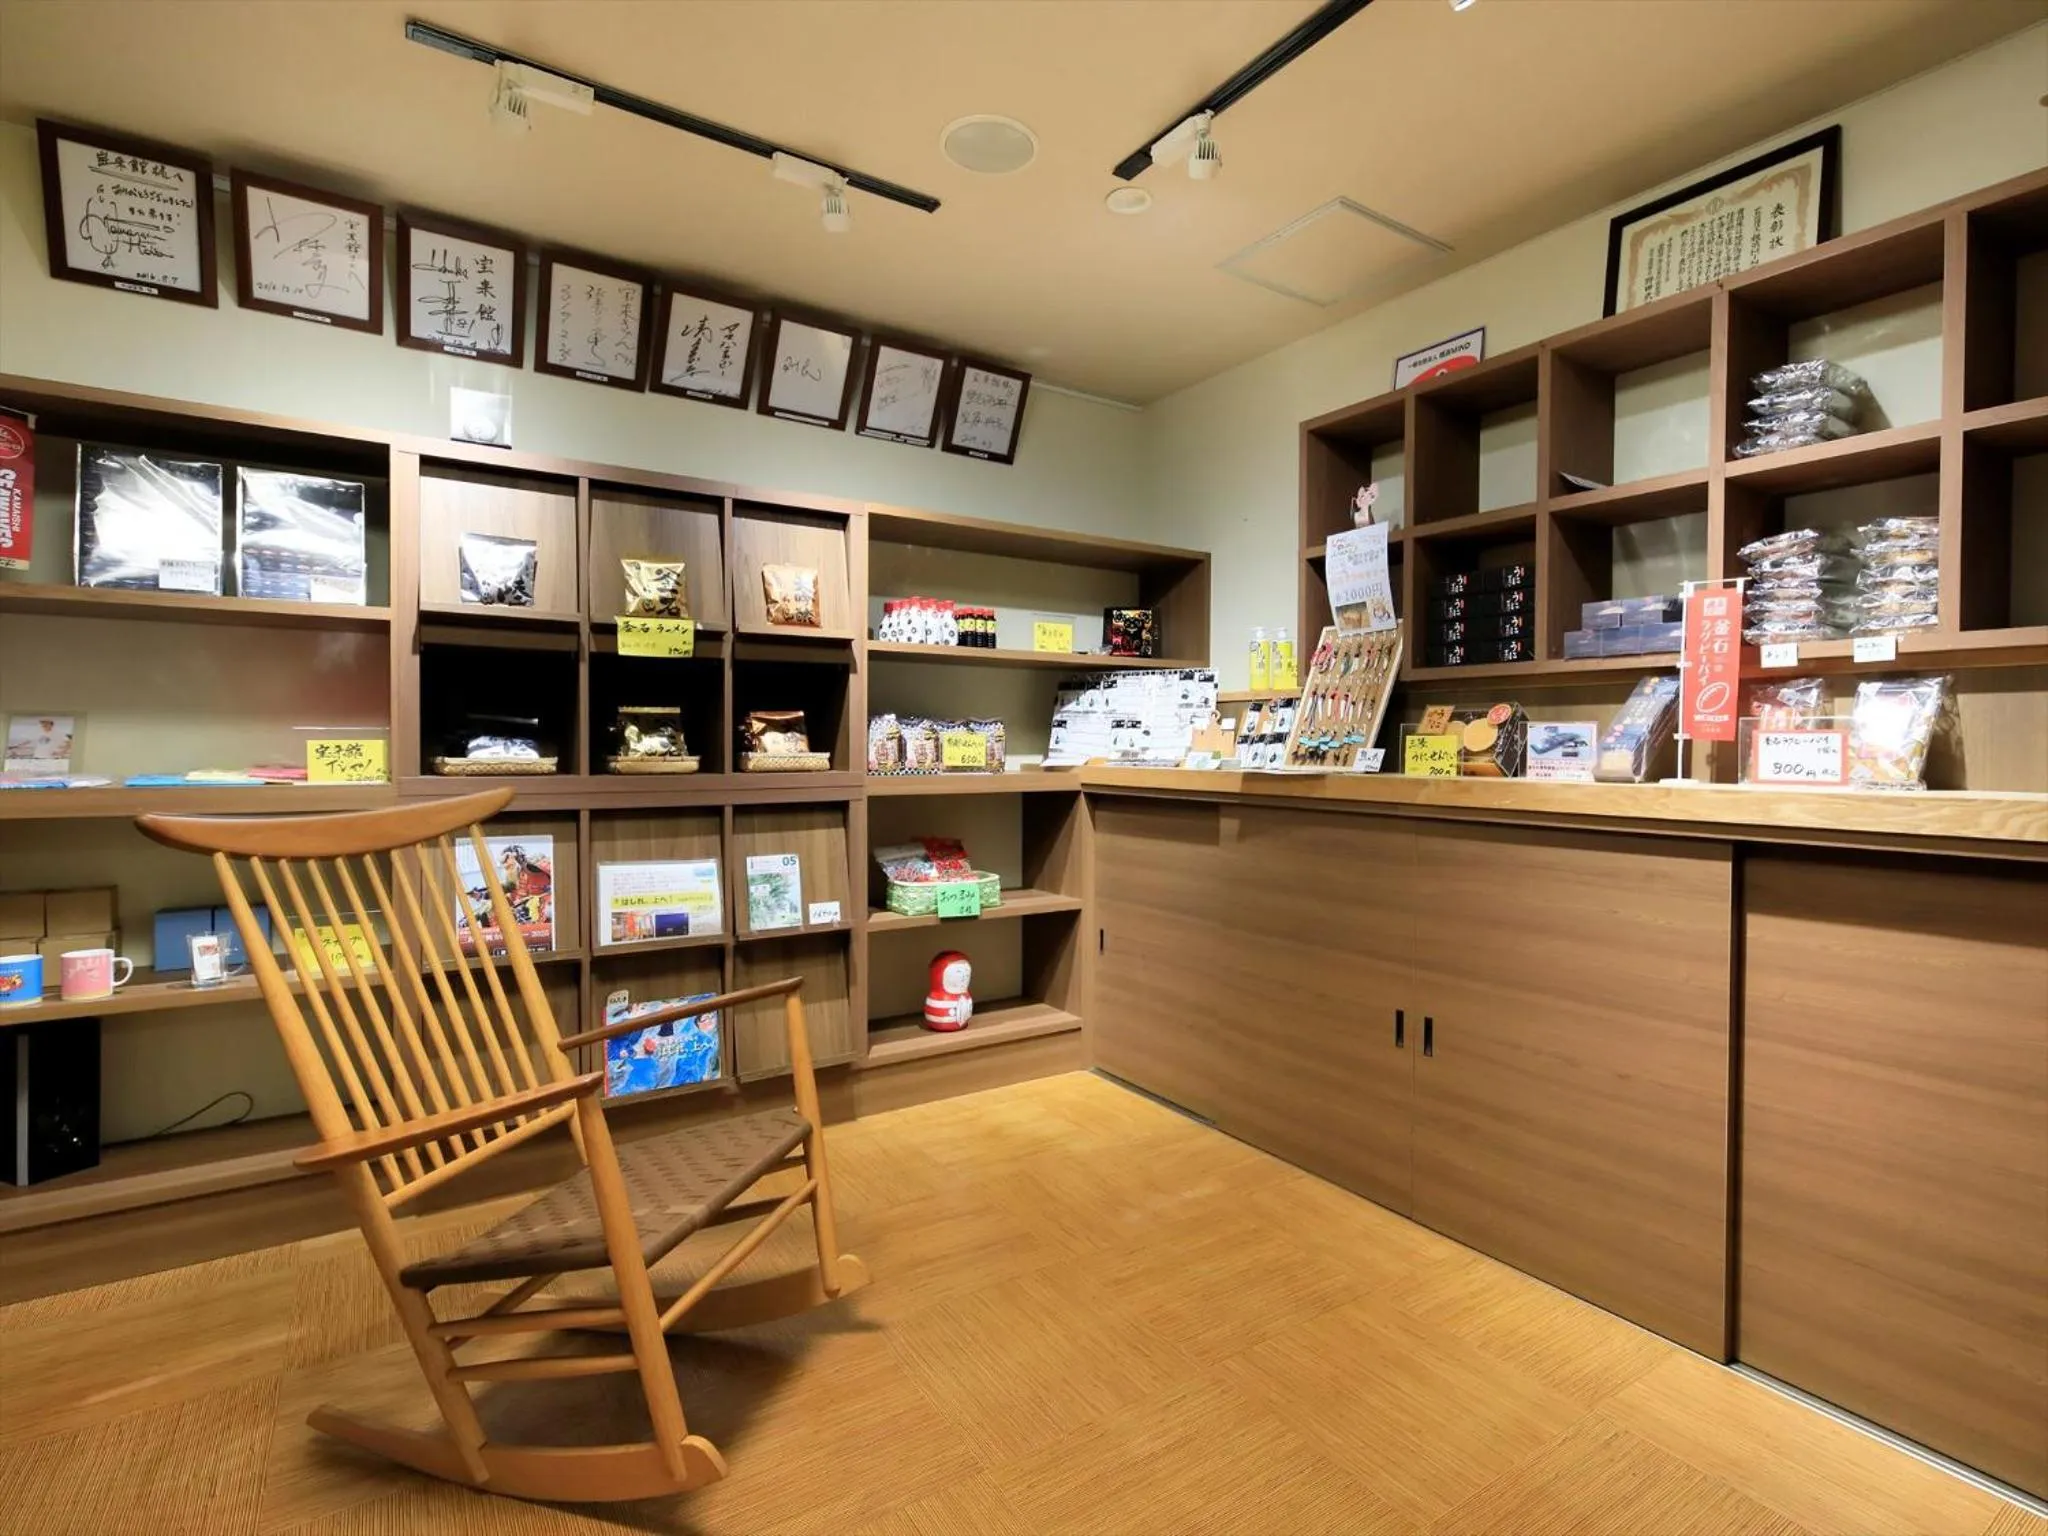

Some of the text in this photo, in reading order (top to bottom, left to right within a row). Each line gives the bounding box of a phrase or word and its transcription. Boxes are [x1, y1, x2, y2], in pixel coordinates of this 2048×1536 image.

[1769, 202, 1785, 250] 表彰状
[1714, 619, 1731, 654] 釜石
[782, 856, 797, 867] 05
